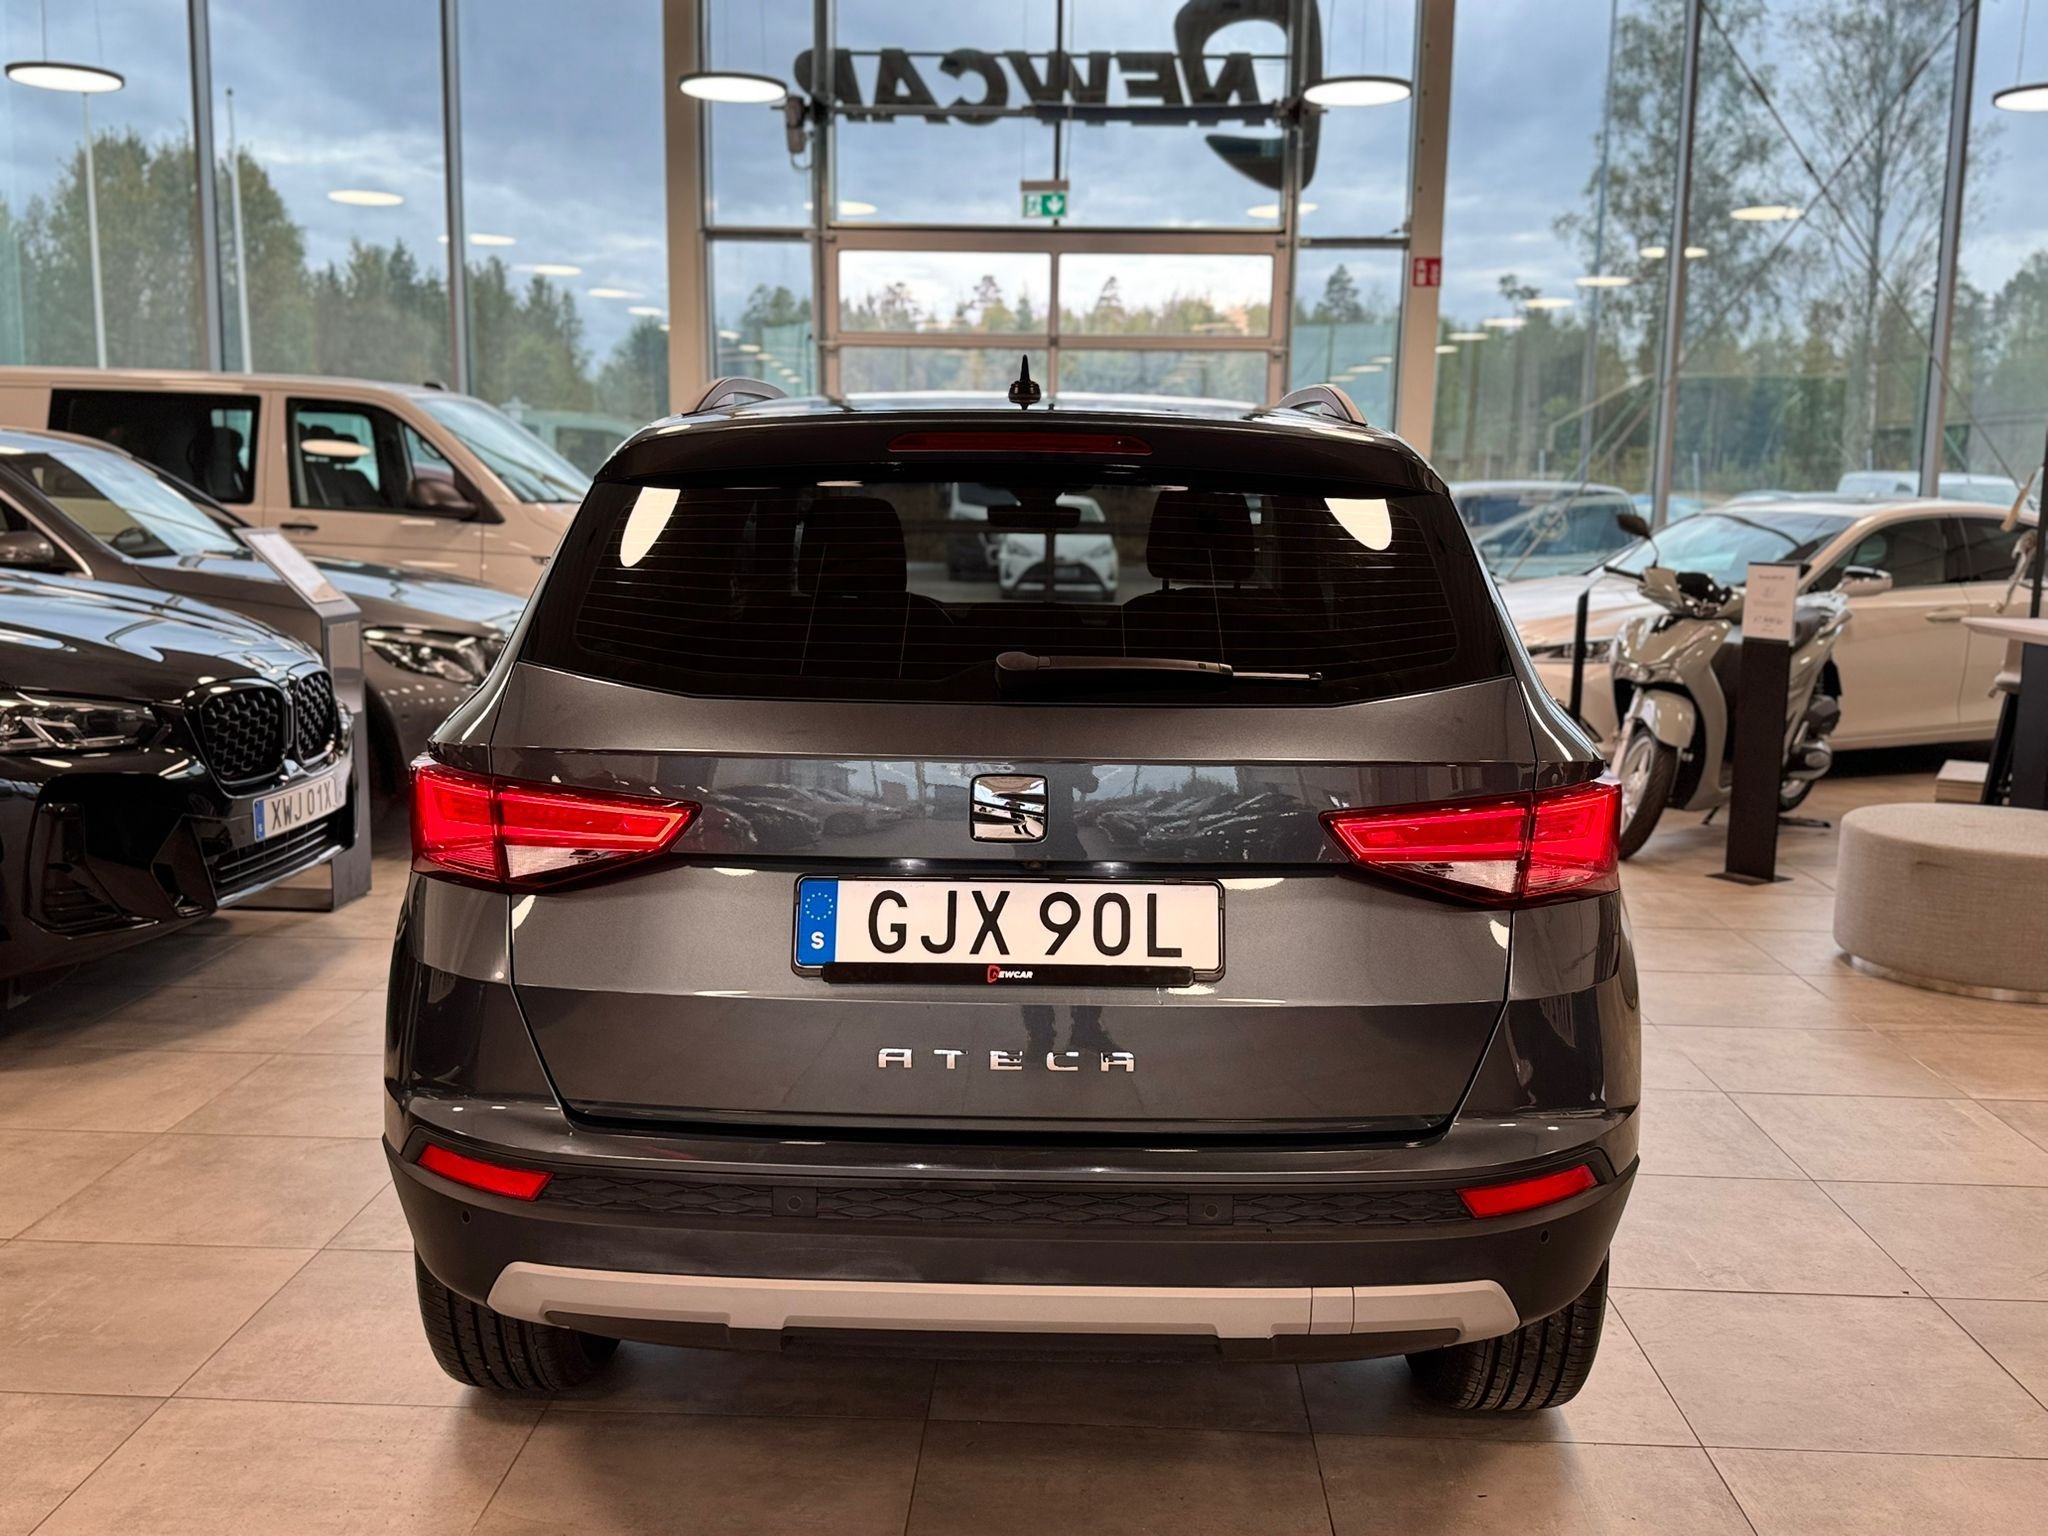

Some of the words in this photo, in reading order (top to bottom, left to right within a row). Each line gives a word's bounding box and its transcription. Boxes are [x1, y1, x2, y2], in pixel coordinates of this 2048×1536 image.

[271, 792, 302, 830] XWJ
[307, 781, 332, 816] 01X
[811, 931, 824, 950] S
[868, 890, 1010, 955] GJX
[1039, 891, 1182, 958] 90L
[878, 1048, 1135, 1072] ATECA
